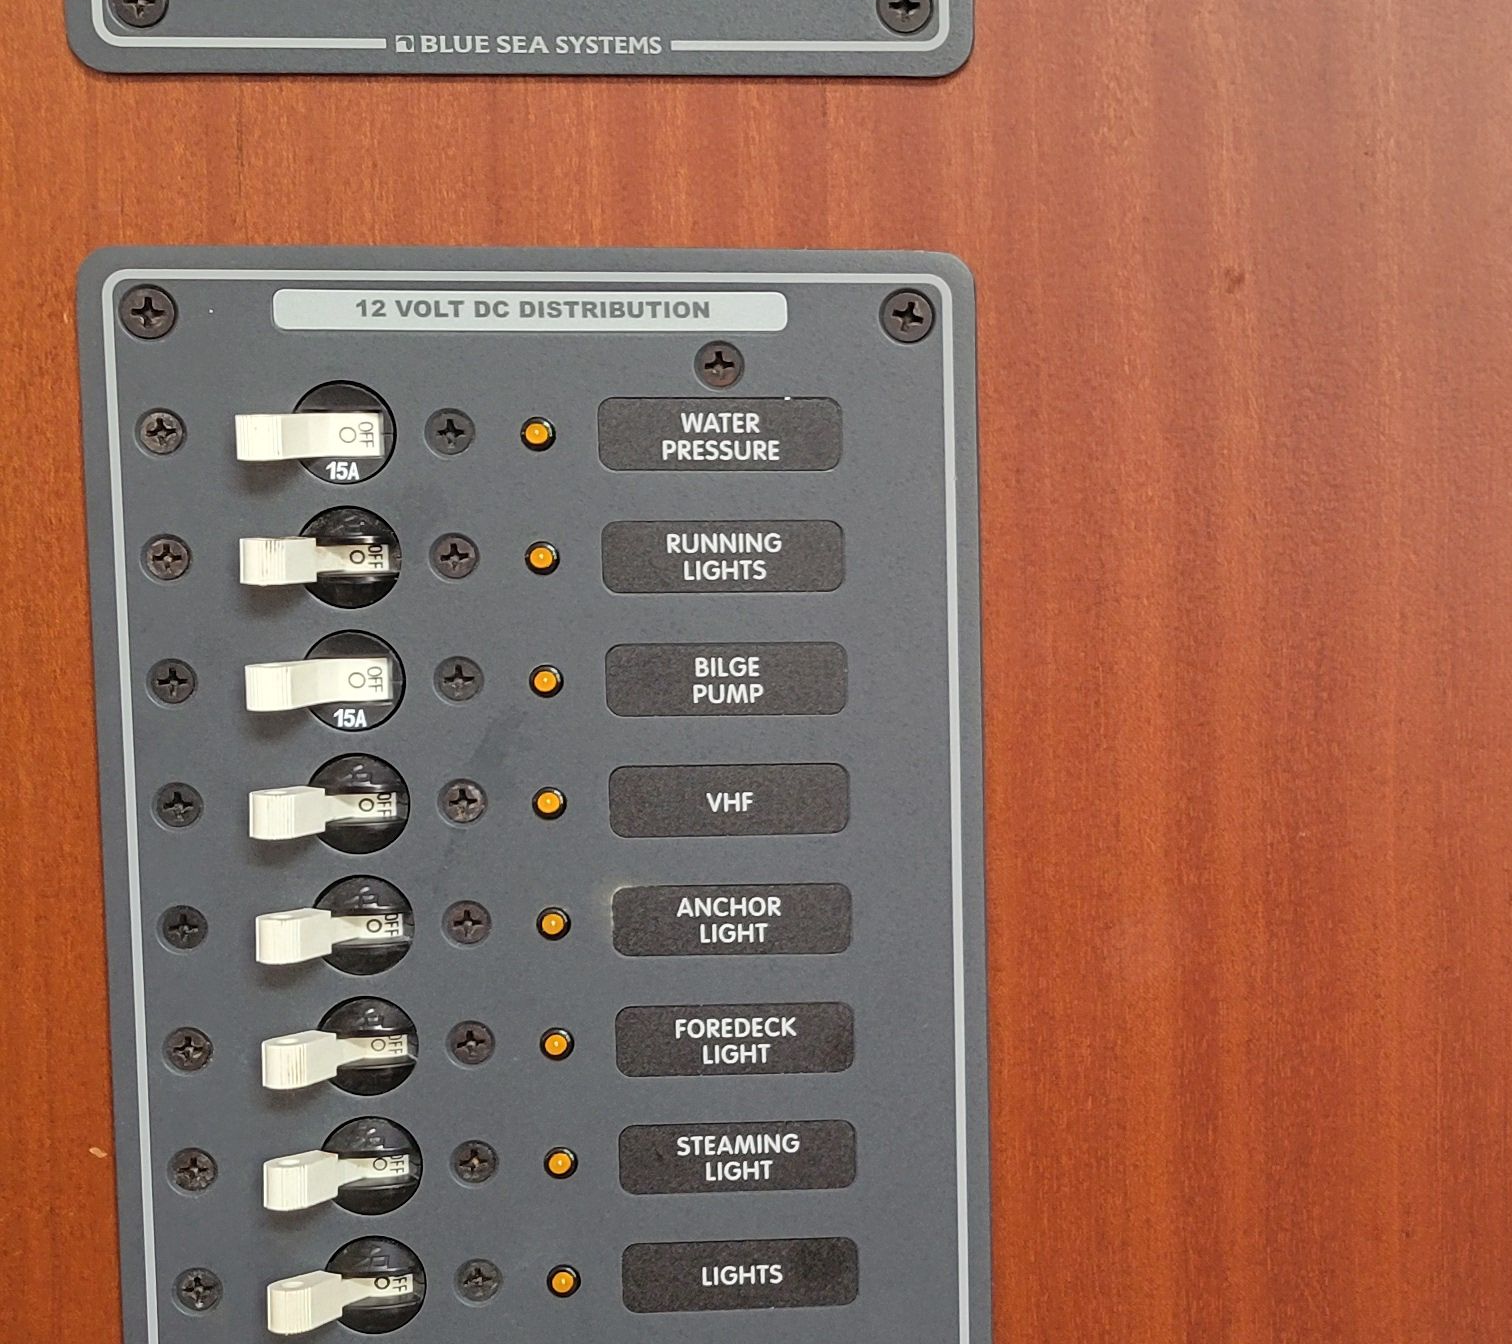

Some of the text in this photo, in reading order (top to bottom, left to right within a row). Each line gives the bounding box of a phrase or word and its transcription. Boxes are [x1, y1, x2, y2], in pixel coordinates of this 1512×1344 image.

[421, 36, 661, 55] BLUE SEA SYSTEMS
[356, 300, 709, 318] 12 VOLT DC DISTRIBUTION
[681, 413, 759, 433] WATER
[358, 421, 375, 448] OFF
[663, 440, 779, 460] PRESSURE
[326, 462, 360, 481] 15A
[667, 533, 781, 553] RUNNING
[368, 543, 384, 569] OFF
[684, 560, 766, 580] LIGHTS
[695, 657, 759, 677] BILGE
[367, 666, 383, 693] OFF
[693, 684, 763, 703] PUMP
[333, 710, 367, 728] 15A
[377, 792, 393, 817] OFF
[707, 792, 753, 812] VHF
[677, 897, 781, 917] ANCHOR
[384, 914, 399, 937] OFF
[700, 923, 768, 943] LIGHT
[676, 1017, 796, 1038] FOREDECK
[703, 1044, 770, 1064] LIGHT
[677, 1134, 799, 1155] STEAMING
[706, 1160, 773, 1181] LIGHT
[393, 1275, 408, 1293] FF
[702, 1265, 783, 1286] LIGHTS
